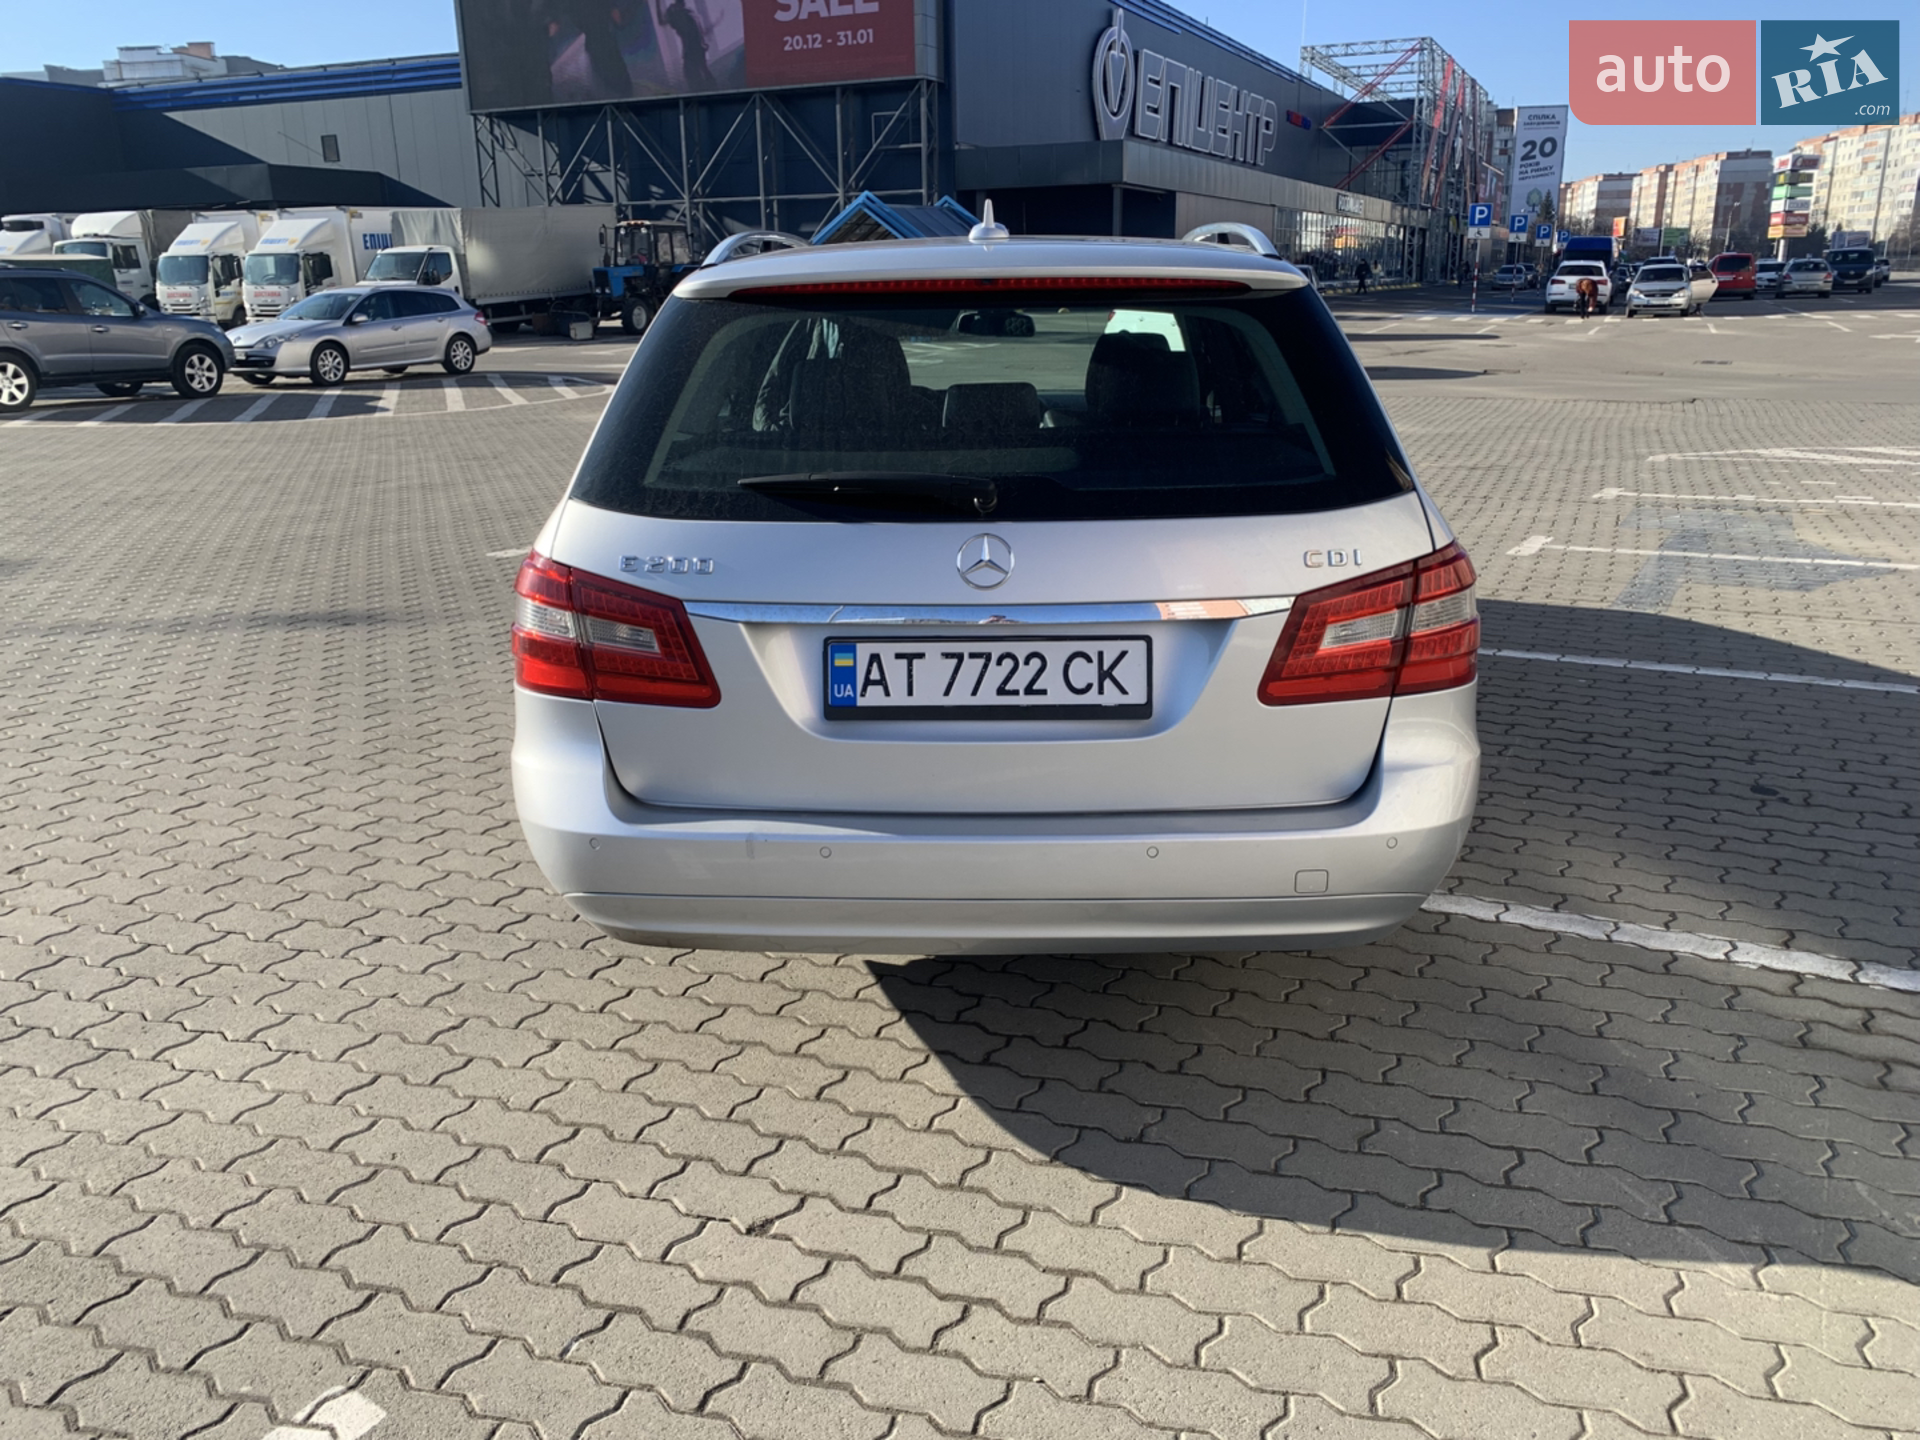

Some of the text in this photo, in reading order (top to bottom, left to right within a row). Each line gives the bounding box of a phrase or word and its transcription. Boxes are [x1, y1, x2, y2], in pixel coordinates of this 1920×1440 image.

[783, 33, 822, 51] 20.12
[836, 28, 873, 46] 31.01
[1134, 48, 1278, 166] ЕПІЦЕНТР
[1527, 113, 1556, 121] СПІЛКА
[1520, 136, 1558, 162] 20
[1519, 161, 1541, 169] РОКІВ
[1518, 169, 1529, 177] НА
[1474, 205, 1488, 225] P
[1513, 216, 1525, 231] P
[1540, 225, 1549, 238] P
[1560, 230, 1568, 240] P
[1303, 548, 1363, 569] CDI
[860, 650, 1130, 697] AT 7722 CK
[834, 683, 854, 698] UA
